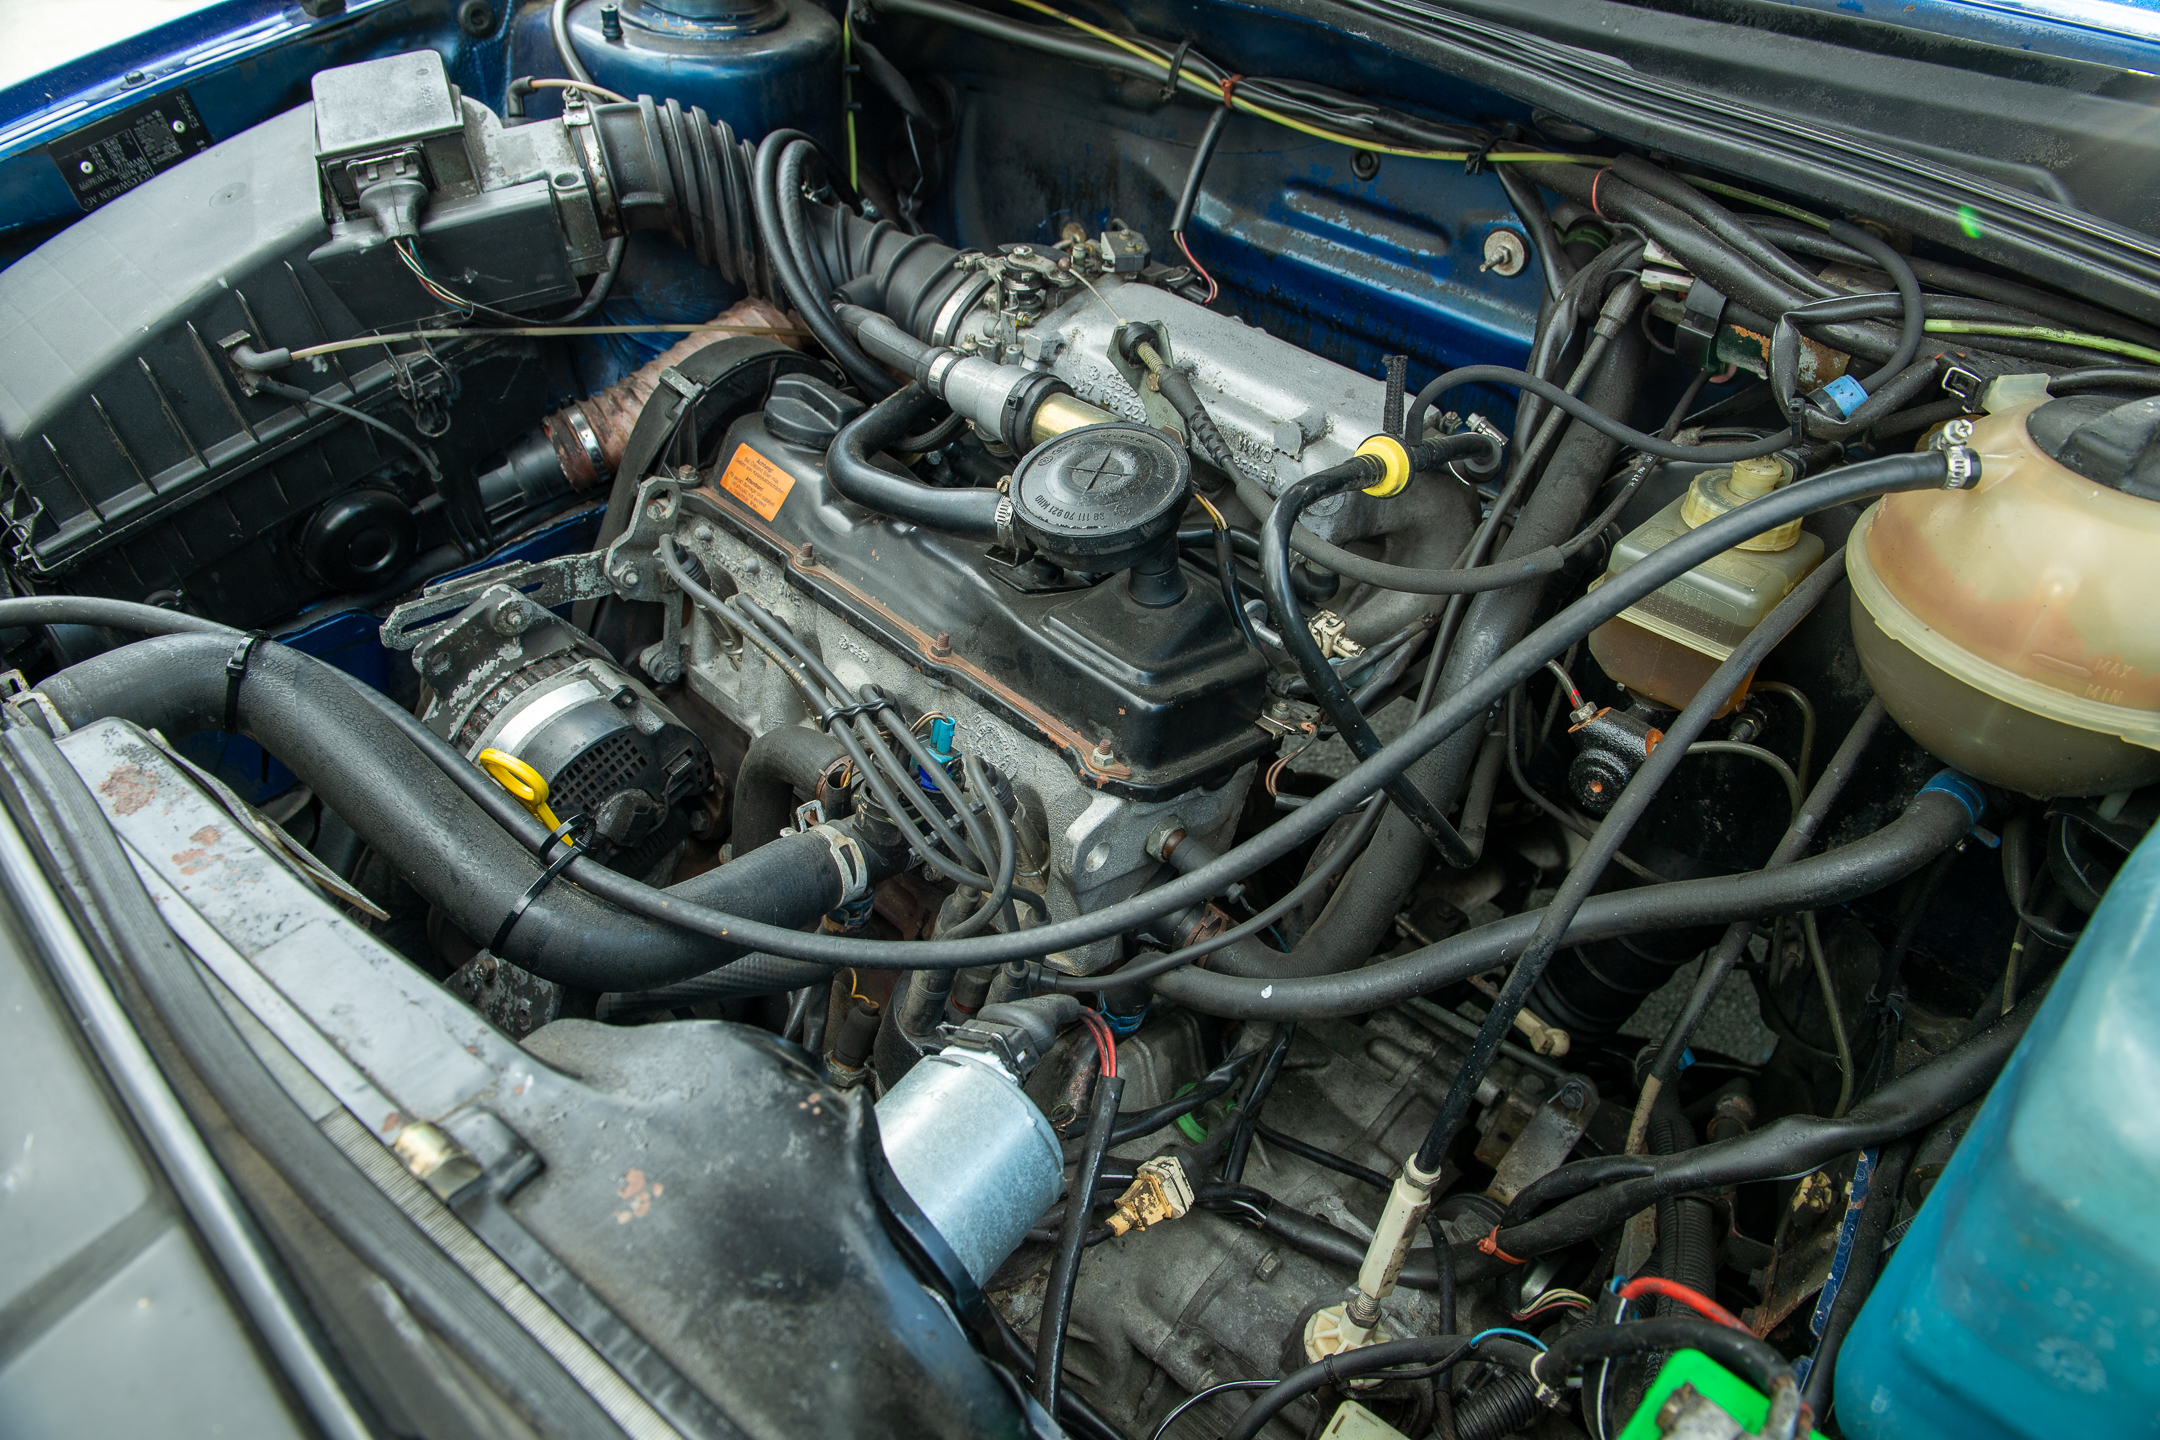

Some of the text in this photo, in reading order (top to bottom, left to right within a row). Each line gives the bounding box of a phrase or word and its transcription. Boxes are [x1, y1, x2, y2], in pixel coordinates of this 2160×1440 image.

[98, 169, 153, 199] VOLKSWAGEN
[82, 194, 98, 207] AG
[756, 458, 774, 473] Achtung!
[1233, 456, 1287, 488] ermany
[745, 476, 763, 491] Attention!
[763, 646, 785, 666] CORE
[783, 663, 807, 688] CABLE
[2094, 658, 2133, 679] MAX
[2084, 683, 2123, 704] MIN
